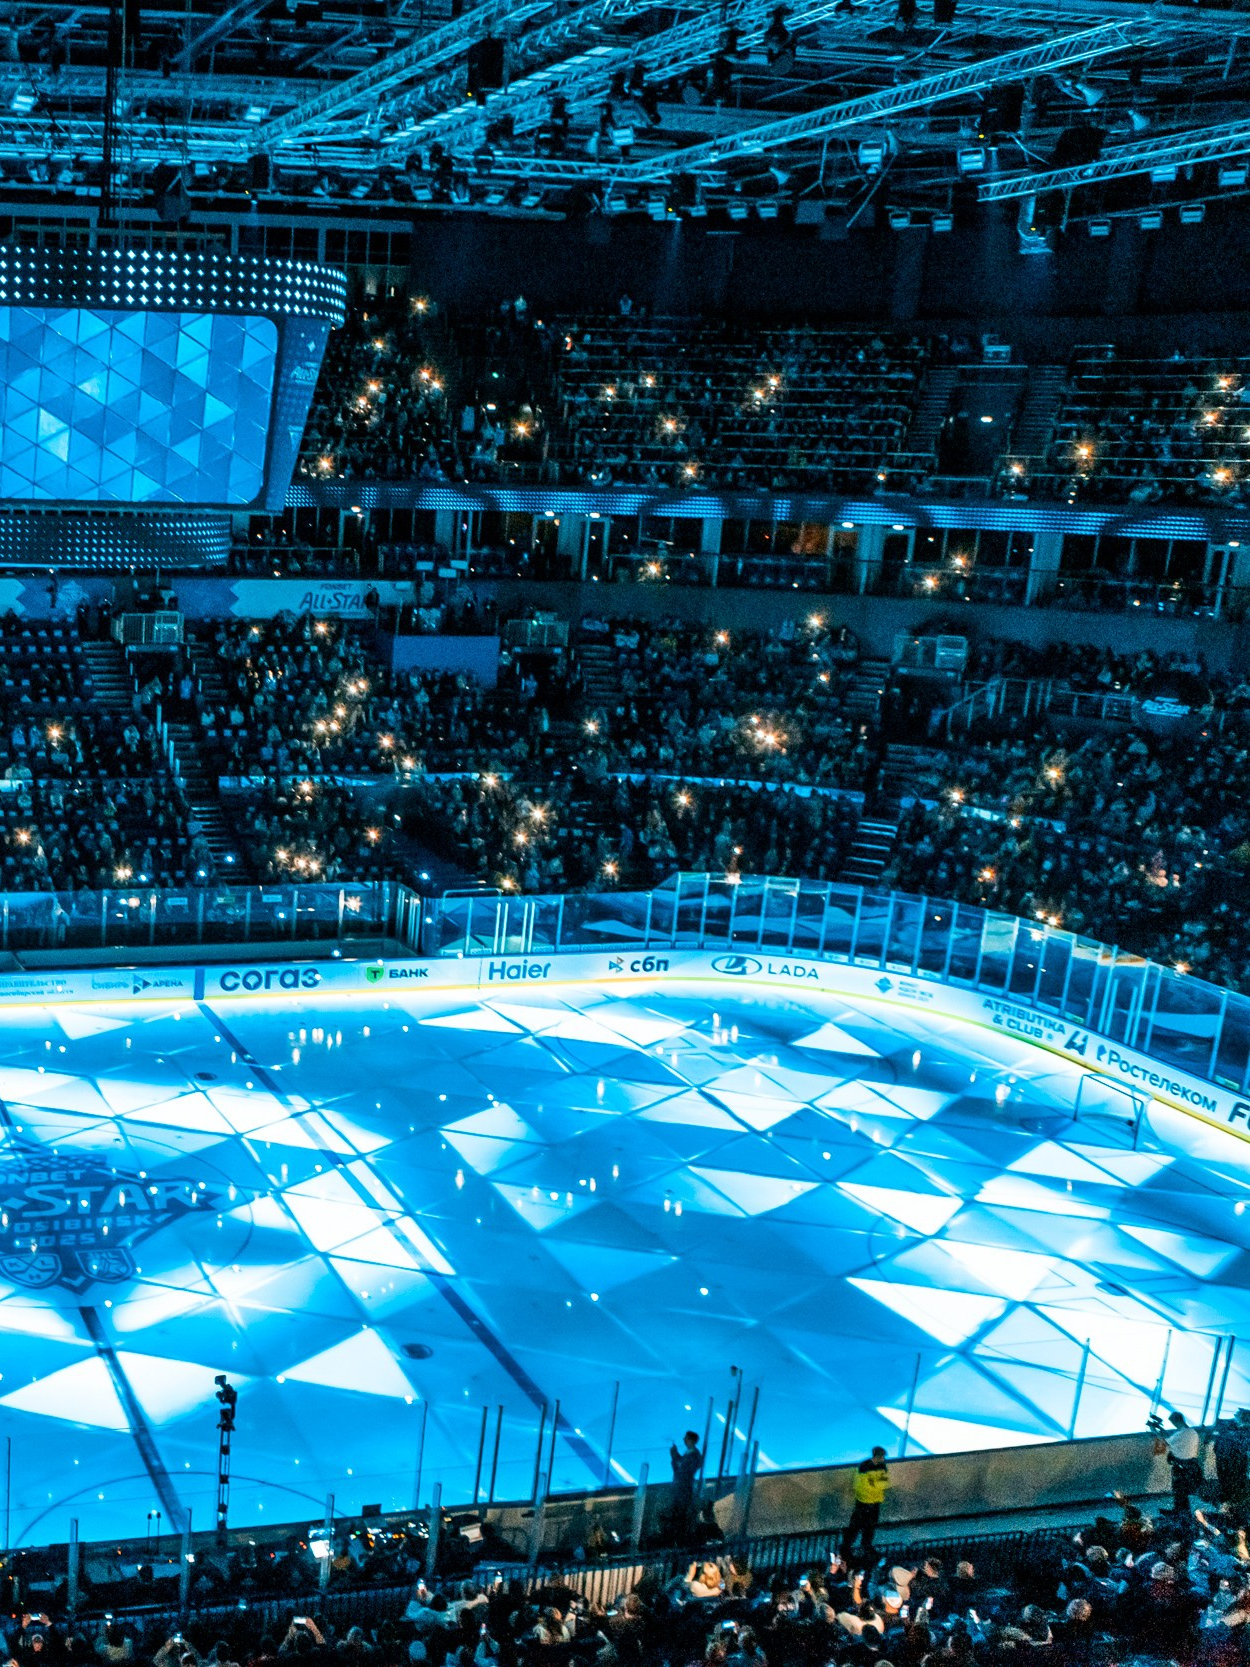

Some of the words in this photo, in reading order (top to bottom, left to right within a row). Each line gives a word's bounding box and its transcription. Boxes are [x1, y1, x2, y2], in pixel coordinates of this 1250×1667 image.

[389, 968, 429, 979] БАНК
[488, 960, 551, 980] Haier
[768, 964, 819, 979] LADA
[152, 979, 184, 988] АРЕНА
[983, 998, 1066, 1036] ATRIBUTIKA
[1006, 1017, 1044, 1040] CLUB
[1107, 1050, 1218, 1113] Ростелеком
